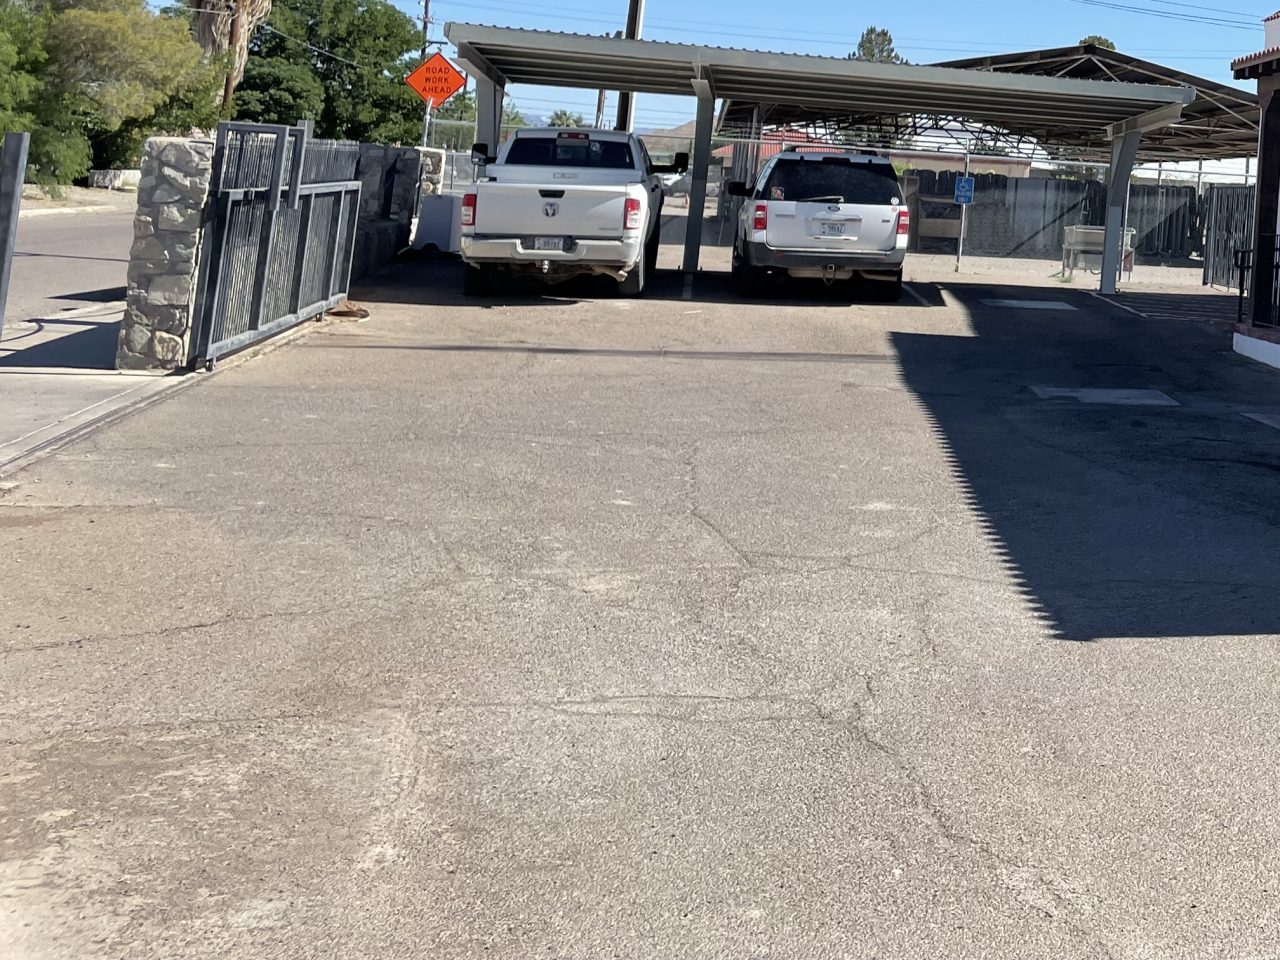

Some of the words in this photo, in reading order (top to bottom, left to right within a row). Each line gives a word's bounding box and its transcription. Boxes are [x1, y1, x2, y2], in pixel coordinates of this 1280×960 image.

[425, 67, 450, 75] ROAD
[424, 76, 449, 84] WORK
[422, 86, 452, 94] AHEAD
